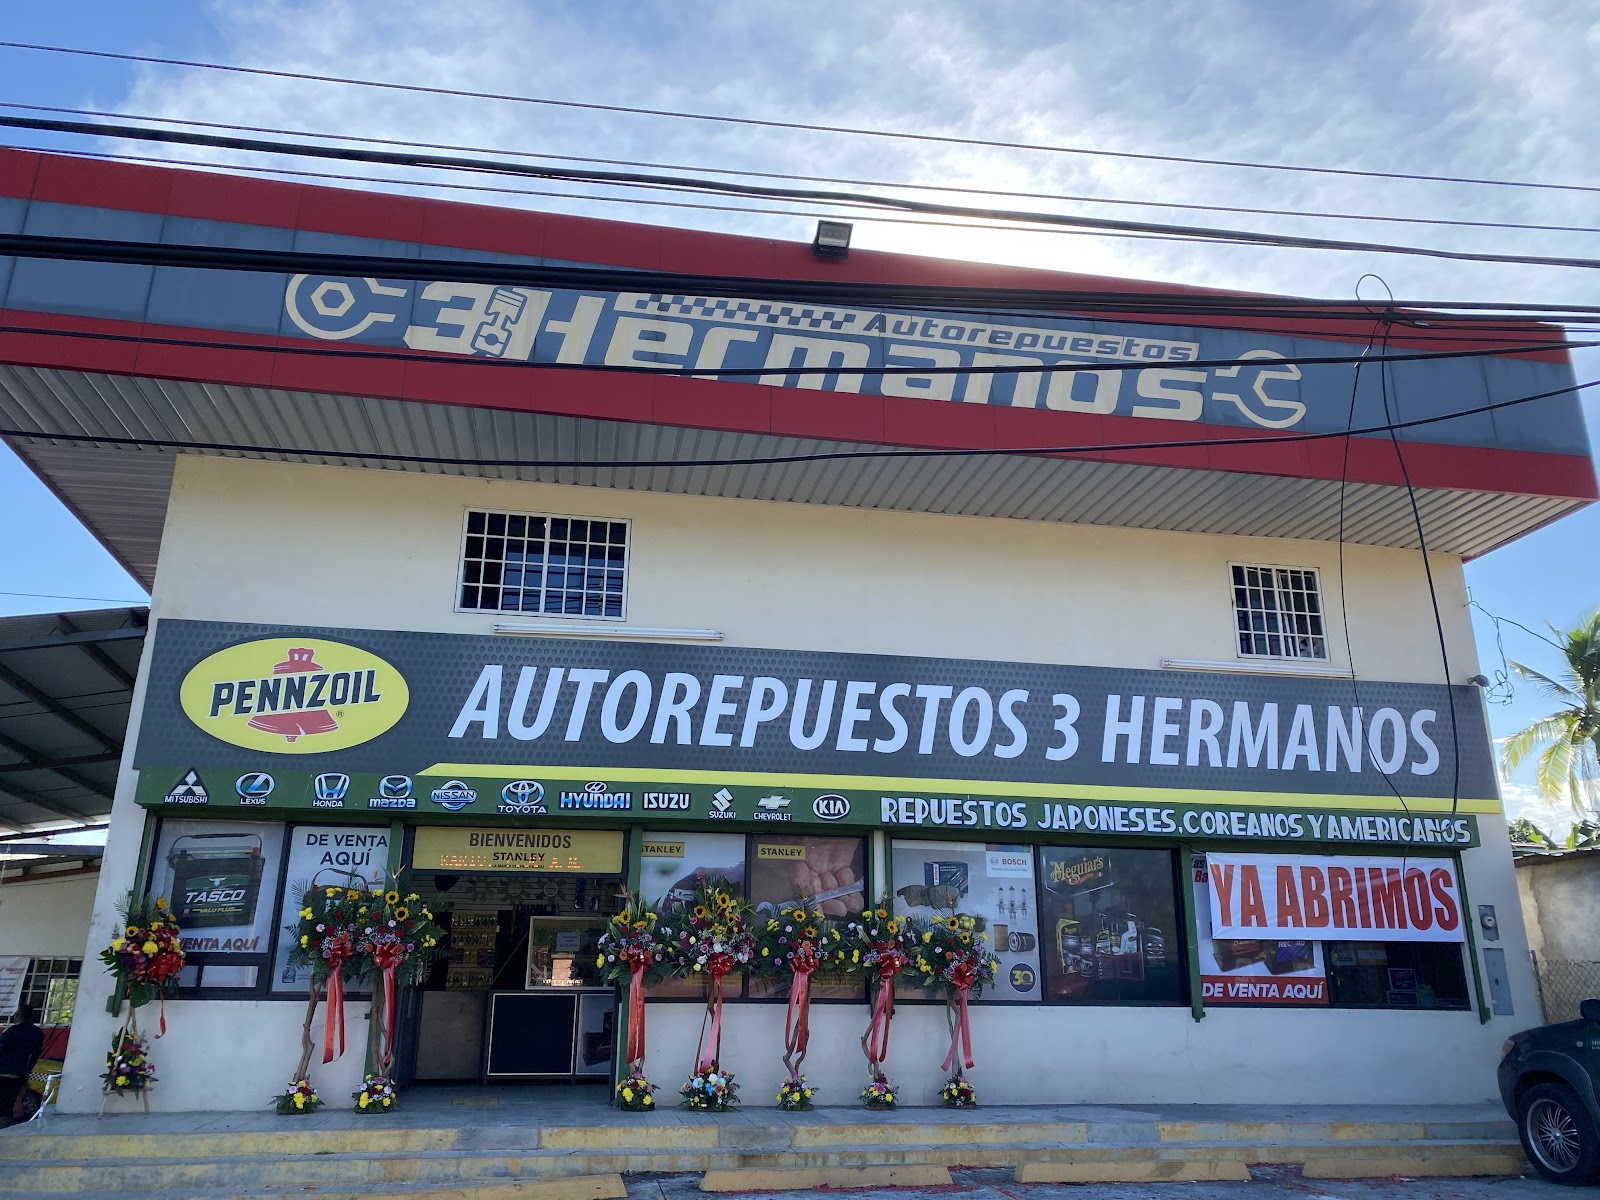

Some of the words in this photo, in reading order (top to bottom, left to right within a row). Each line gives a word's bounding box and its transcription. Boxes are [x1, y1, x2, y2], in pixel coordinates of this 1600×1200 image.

[862, 311, 1194, 362] Autorepuestos
[486, 287, 1204, 421] Hermanos
[206, 669, 384, 718] PENNZOIL
[448, 664, 1030, 760] AUTOREPUESTOS
[1045, 693, 1081, 762] 3
[1101, 693, 1441, 776] HERMANOS
[164, 795, 208, 804] MITSUBISHI
[433, 791, 475, 800] NISSAN
[560, 792, 631, 809] HYUNDAI
[643, 793, 690, 809] ISUZU
[312, 800, 343, 808] HONDA
[497, 805, 547, 814] TOYOTA
[818, 800, 845, 815] KIA
[708, 811, 736, 819] SUZUKI
[753, 812, 792, 821] CHEVROLET
[881, 796, 1027, 829] REPUESTOS
[1327, 815, 1471, 844] AMERICANOS
[306, 833, 329, 847] DE
[334, 834, 388, 848] VENTA
[469, 832, 572, 849] BIENVENIDOS
[320, 848, 371, 866] AQUÍ
[492, 852, 545, 862] STANLEY
[760, 847, 803, 857] STANLEY
[1002, 858, 1027, 866] BOSCH
[185, 889, 247, 904] TASCO
[1209, 863, 1268, 927] YA
[1277, 864, 1460, 932] ABRIMOS
[221, 935, 260, 951] AQUÍ
[1201, 982, 1224, 997] DE
[1227, 983, 1280, 998] VENTA
[1282, 981, 1324, 999] AQUÍ
